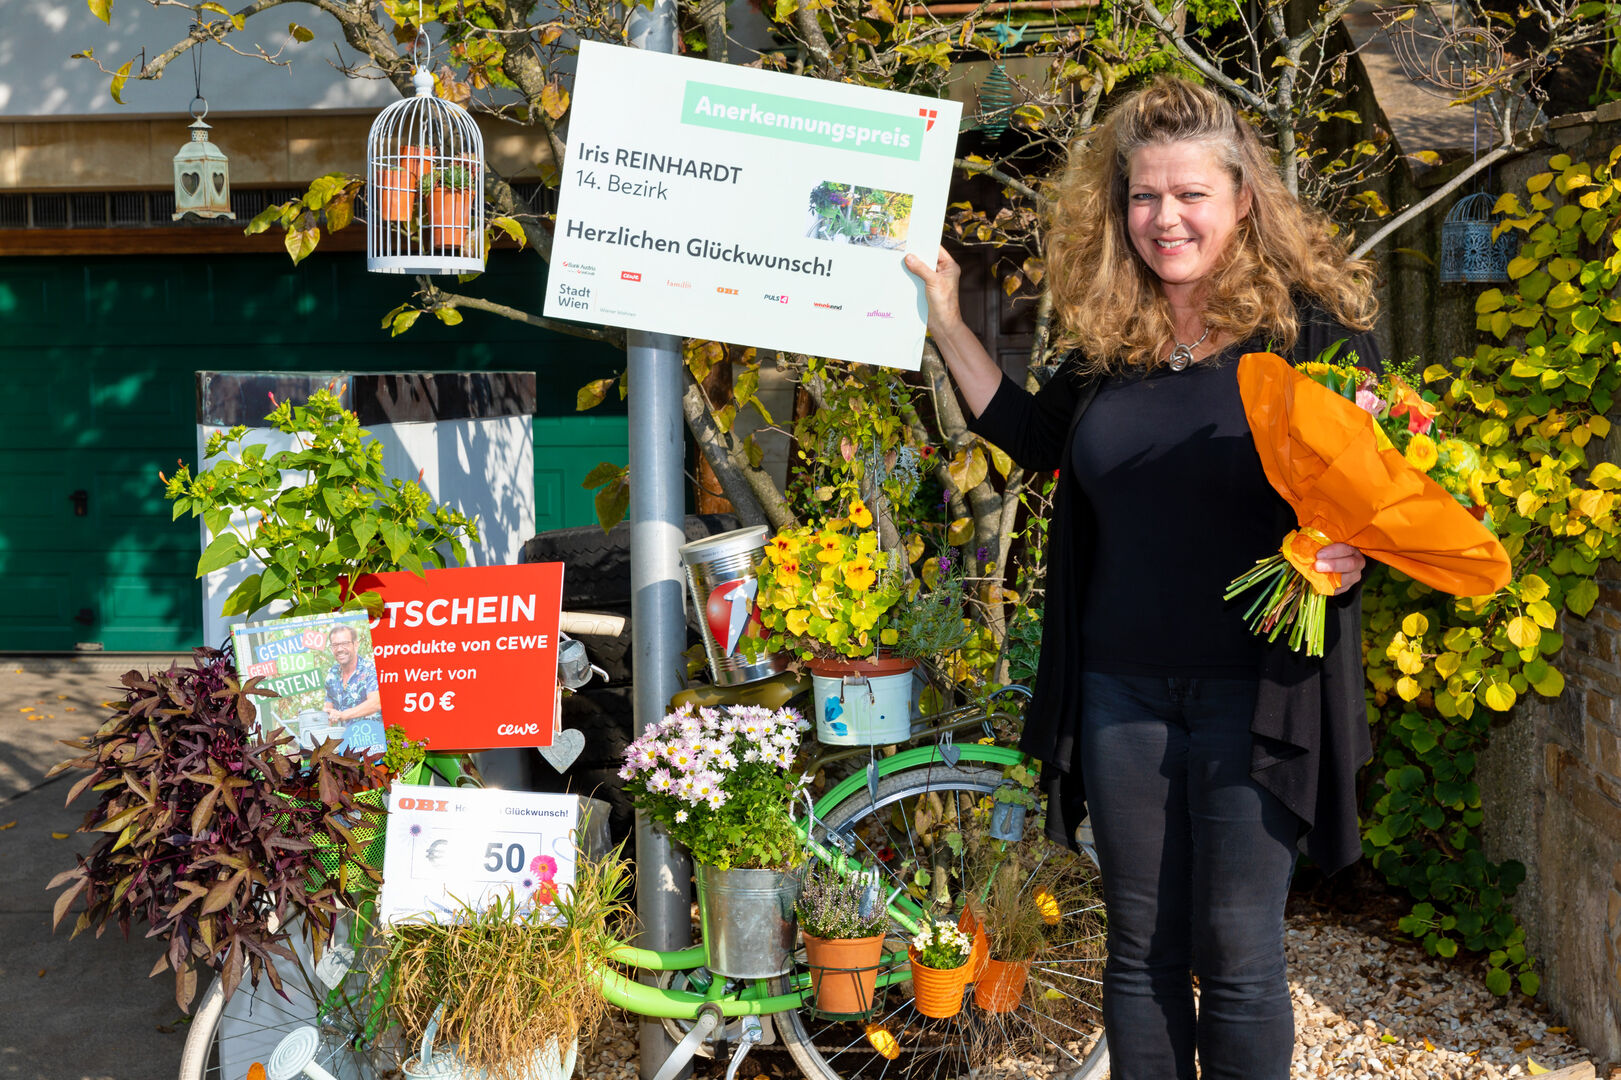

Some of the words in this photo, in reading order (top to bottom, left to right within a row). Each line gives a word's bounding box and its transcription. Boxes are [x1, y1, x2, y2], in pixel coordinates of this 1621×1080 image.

[694, 95, 911, 148] Anerkennungspreis
[578, 142, 609, 164] Iris
[615, 148, 743, 185] REINHARDT
[576, 169, 601, 190] 14.
[607, 174, 668, 201] Bezirk
[566, 219, 680, 254] Herzlichen
[686, 238, 833, 277] Glückwunsch!
[559, 283, 591, 298] Stadt
[716, 286, 739, 296] OBI
[764, 294, 780, 302] PULS
[558, 296, 589, 310] Wien
[370, 594, 536, 630] TSCHEIN
[259, 634, 305, 661] GENAU
[304, 631, 324, 647] SO
[461, 640, 491, 652] von
[495, 635, 549, 651] CEWE
[250, 662, 275, 678] GEHT
[279, 655, 313, 672] BIO-
[379, 669, 399, 684] im
[404, 668, 443, 683] Wert
[448, 668, 477, 681] von
[403, 691, 435, 713] 50
[439, 690, 456, 711] €
[351, 723, 372, 737] 20
[497, 722, 540, 736] cewe
[348, 733, 378, 748] JAHRE
[398, 797, 449, 812] OBI
[504, 806, 569, 818] Glückwunsch!
[483, 842, 526, 874] 50
